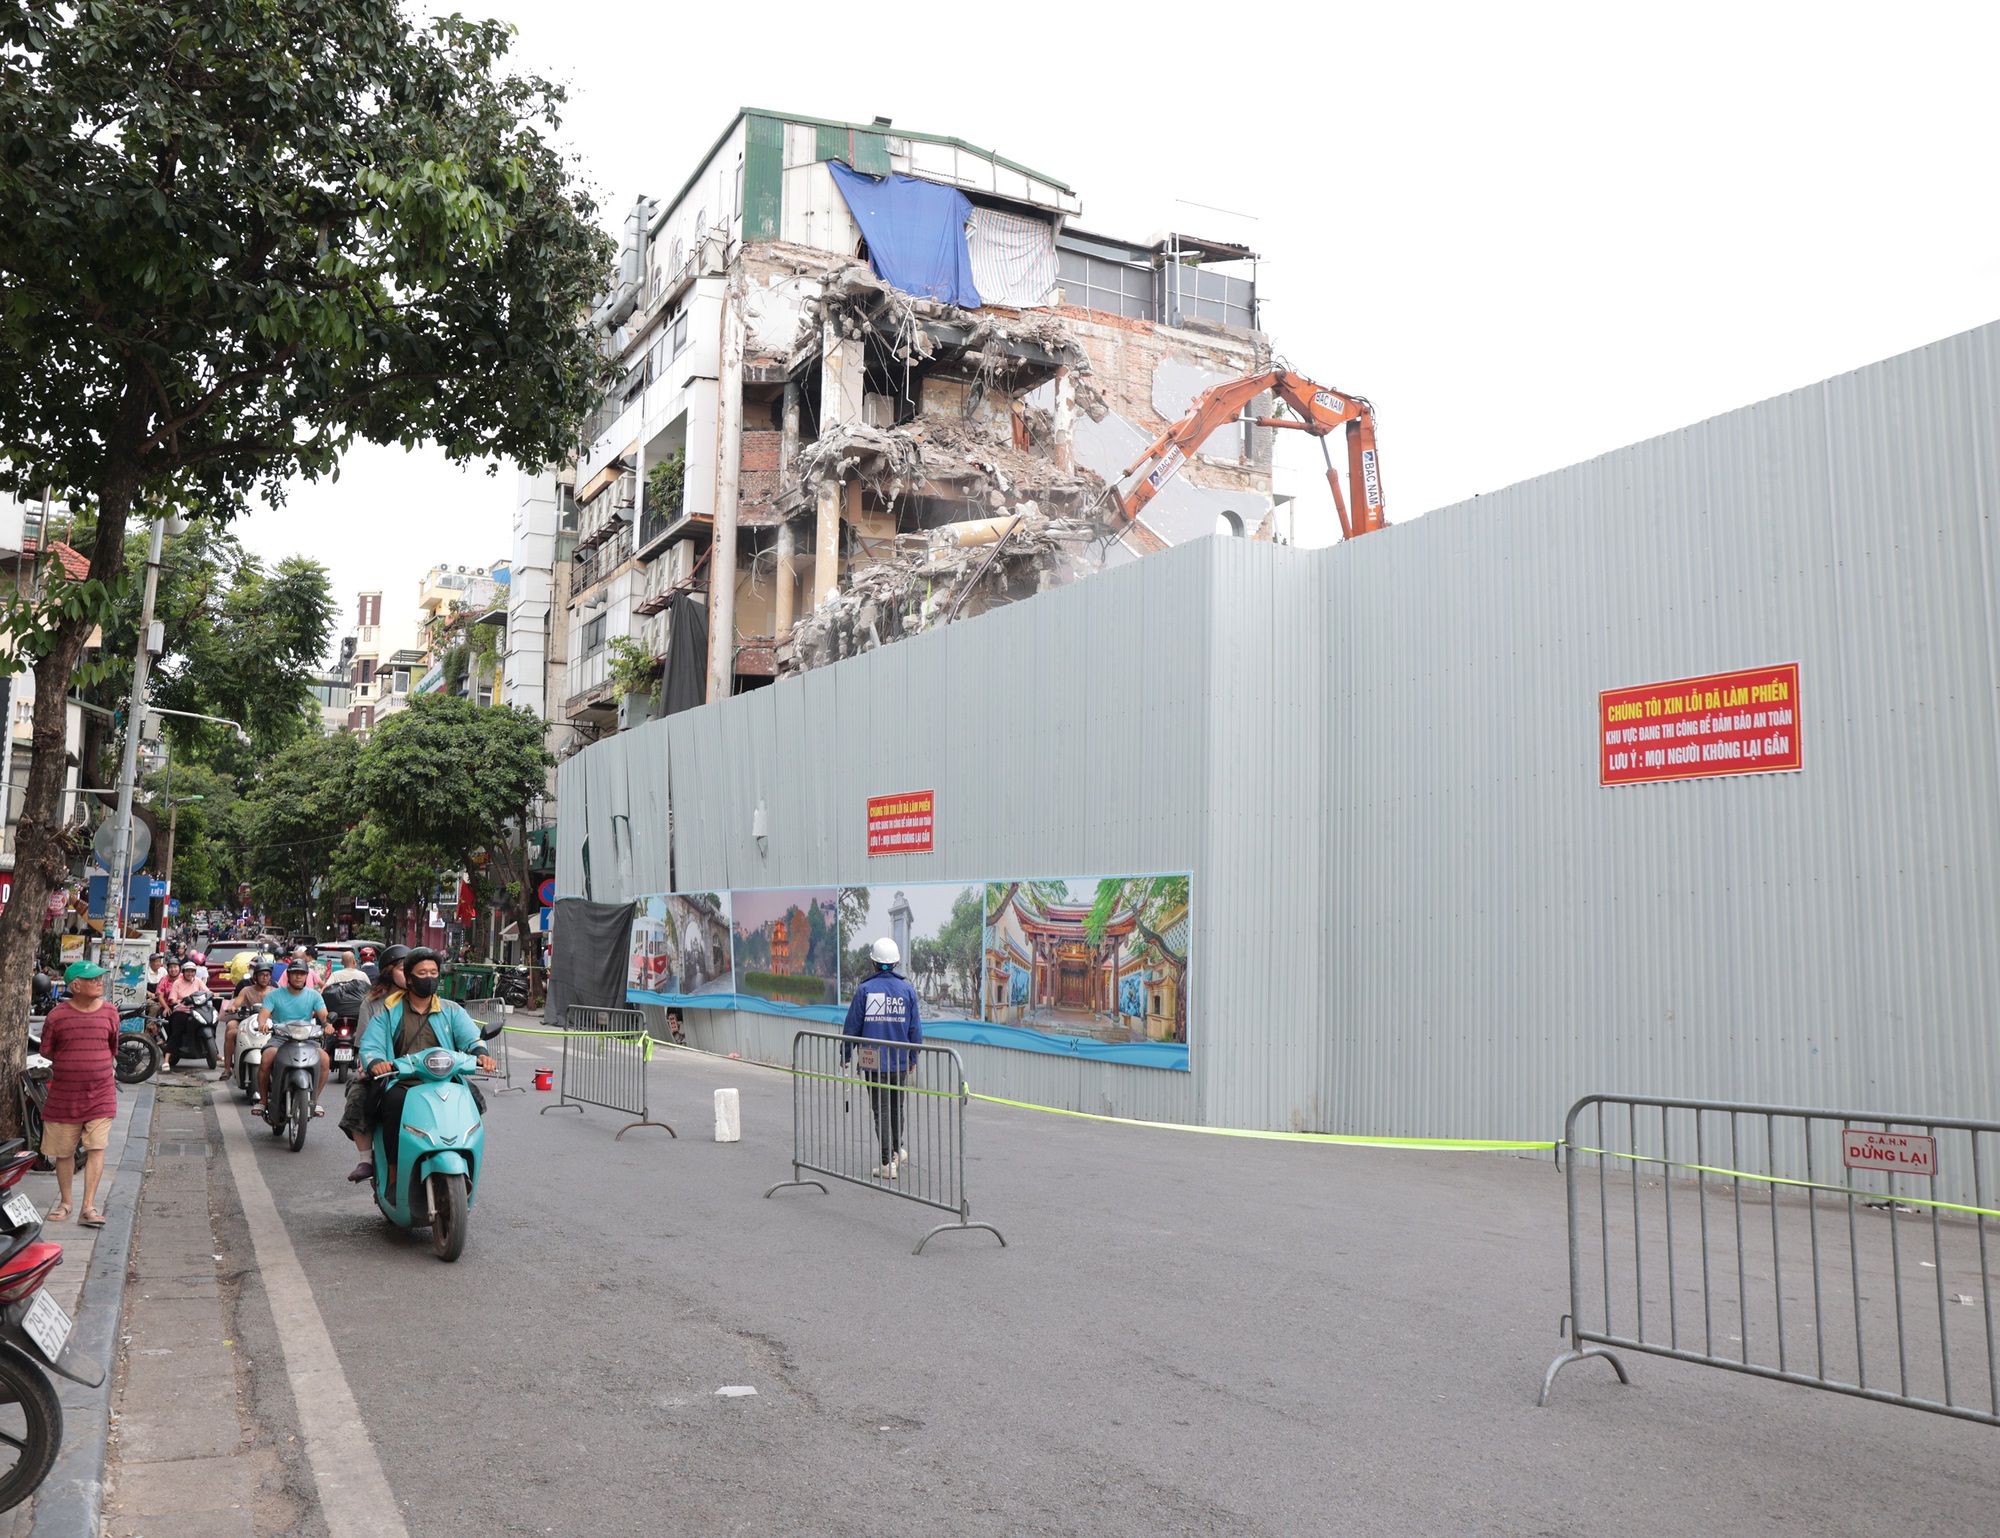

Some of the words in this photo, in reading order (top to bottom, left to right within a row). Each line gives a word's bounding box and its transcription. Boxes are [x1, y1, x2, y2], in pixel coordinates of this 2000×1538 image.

[1316, 391, 1329, 406] BAC
[1329, 398, 1344, 412] NAM
[1157, 459, 1170, 473] BAC
[1168, 447, 1180, 462] NAM
[1365, 462, 1376, 482] BAC
[1367, 484, 1379, 505] NAM
[1608, 700, 1643, 722] CHÚNG
[1645, 696, 1661, 717] TÔI
[1664, 696, 1683, 715] XIN
[1685, 688, 1702, 712] LỖI
[1705, 688, 1721, 710] ĐÃ
[1723, 685, 1749, 707] LÀM
[1751, 677, 1788, 704] PHIỀN
[1606, 729, 1621, 745] KHU
[1622, 727, 1638, 746] VỰC
[1638, 725, 1660, 741] ĐANG
[1661, 723, 1674, 738] THI
[1676, 719, 1698, 737] CÔNG
[1699, 713, 1711, 734] ĐỂ
[1712, 712, 1732, 733] ĐẢM
[1733, 710, 1752, 730] BẢO
[1753, 712, 1766, 728] AN
[1768, 707, 1792, 726] TOÀN
[1609, 752, 1628, 770] LƯU
[1630, 748, 1637, 768] Ý
[1645, 749, 1665, 770] MỌI
[1667, 741, 1700, 765] NGƯỜI
[1702, 739, 1741, 762] KHÔNG
[1743, 739, 1761, 761] LẠI
[1764, 731, 1789, 756] GẦN
[886, 997, 903, 1006] BAC
[886, 1005, 905, 1015] NAM
[862, 1057, 874, 1065] STOP
[1868, 1136, 1907, 1146] C.A.H.N
[1850, 1144, 1896, 1161] DỪNG
[1900, 1151, 1927, 1166] LẠI
